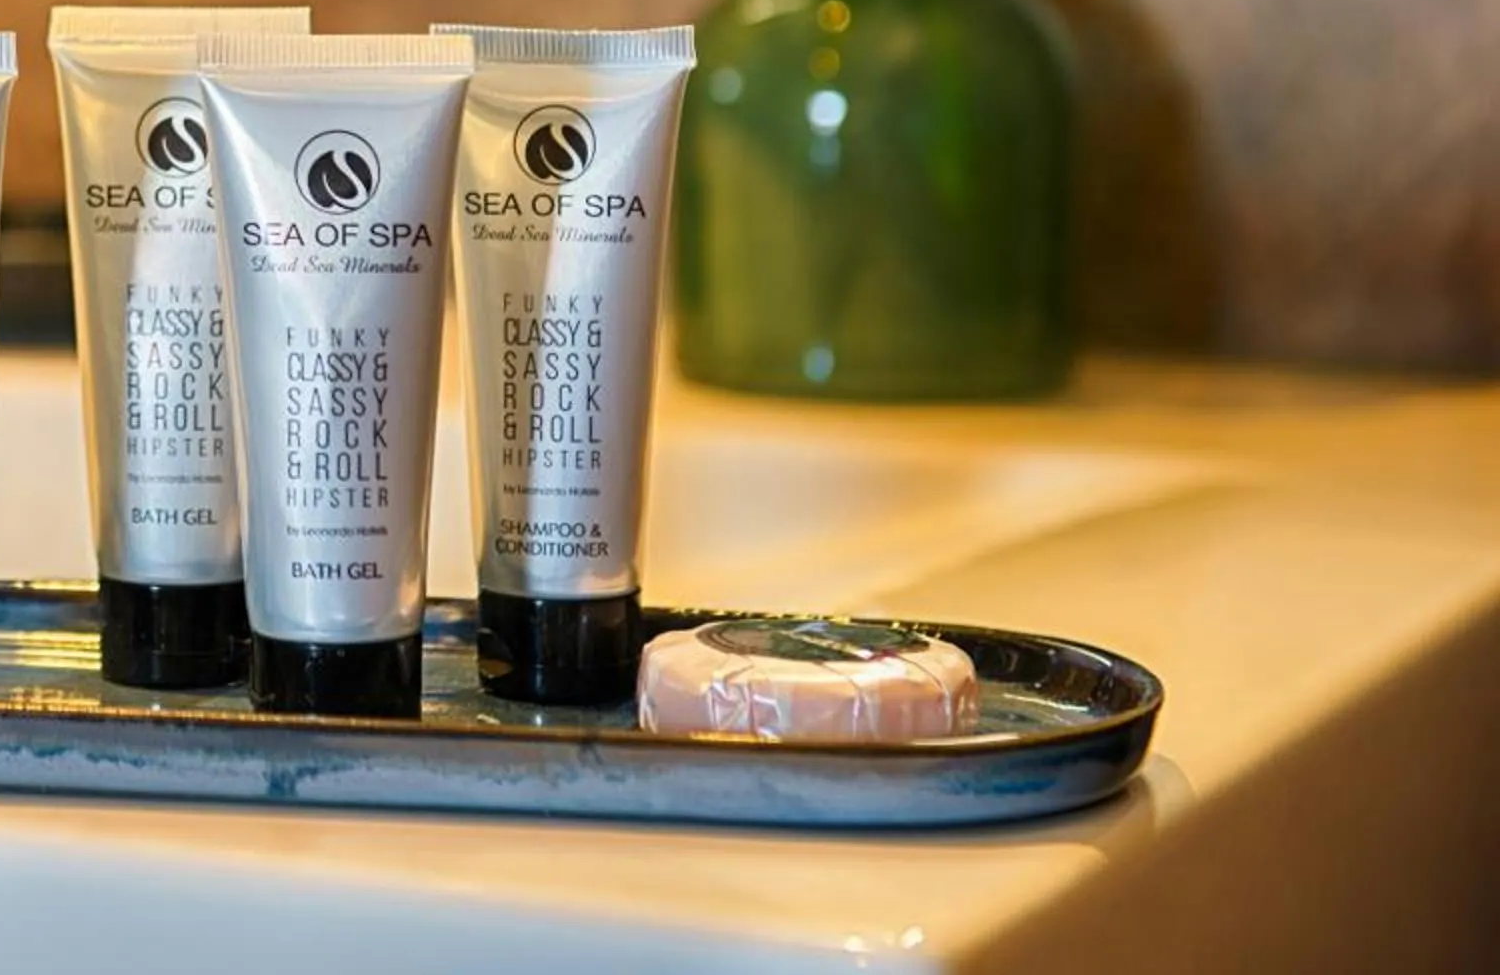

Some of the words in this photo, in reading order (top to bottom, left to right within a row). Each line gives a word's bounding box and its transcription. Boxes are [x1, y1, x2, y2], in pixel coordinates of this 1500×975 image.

[86, 184, 145, 208] SEA
[155, 185, 197, 209] OF
[464, 192, 522, 216] SEA
[531, 193, 574, 217] OF
[584, 194, 646, 218] SPA
[243, 222, 305, 246] SEA
[315, 222, 359, 247] OF
[369, 223, 433, 248] SPA
[126, 283, 224, 303] FUNKY
[503, 293, 603, 314] FUNKY
[128, 308, 203, 337] CLASSY
[209, 309, 224, 337] &
[504, 318, 581, 347] CLASSY
[588, 319, 601, 347] &
[286, 326, 389, 347] FUNKY
[127, 341, 224, 370] SASSY
[287, 352, 367, 382] CLASSY
[373, 352, 388, 382] &
[503, 350, 601, 380] SASSY
[127, 371, 224, 401] ROCK
[503, 382, 601, 412] ROCK
[287, 386, 388, 417] SASSY
[127, 402, 141, 430] &
[154, 403, 224, 432] ROLL
[503, 412, 516, 441] &
[529, 414, 602, 443] ROLL
[127, 436, 224, 457] HIPSTER
[287, 418, 387, 450] ROCK
[287, 451, 300, 480] &
[315, 451, 388, 481] ROLL
[503, 448, 602, 469] HIPSTER
[286, 487, 389, 508] HIPSTER
[131, 507, 178, 525] BATH
[183, 507, 218, 526] GEL
[500, 519, 586, 538] SHAMPOO
[590, 523, 603, 538] &
[495, 536, 610, 558] CONDITIONER
[291, 561, 341, 580] BATH
[347, 561, 384, 580] GEL
